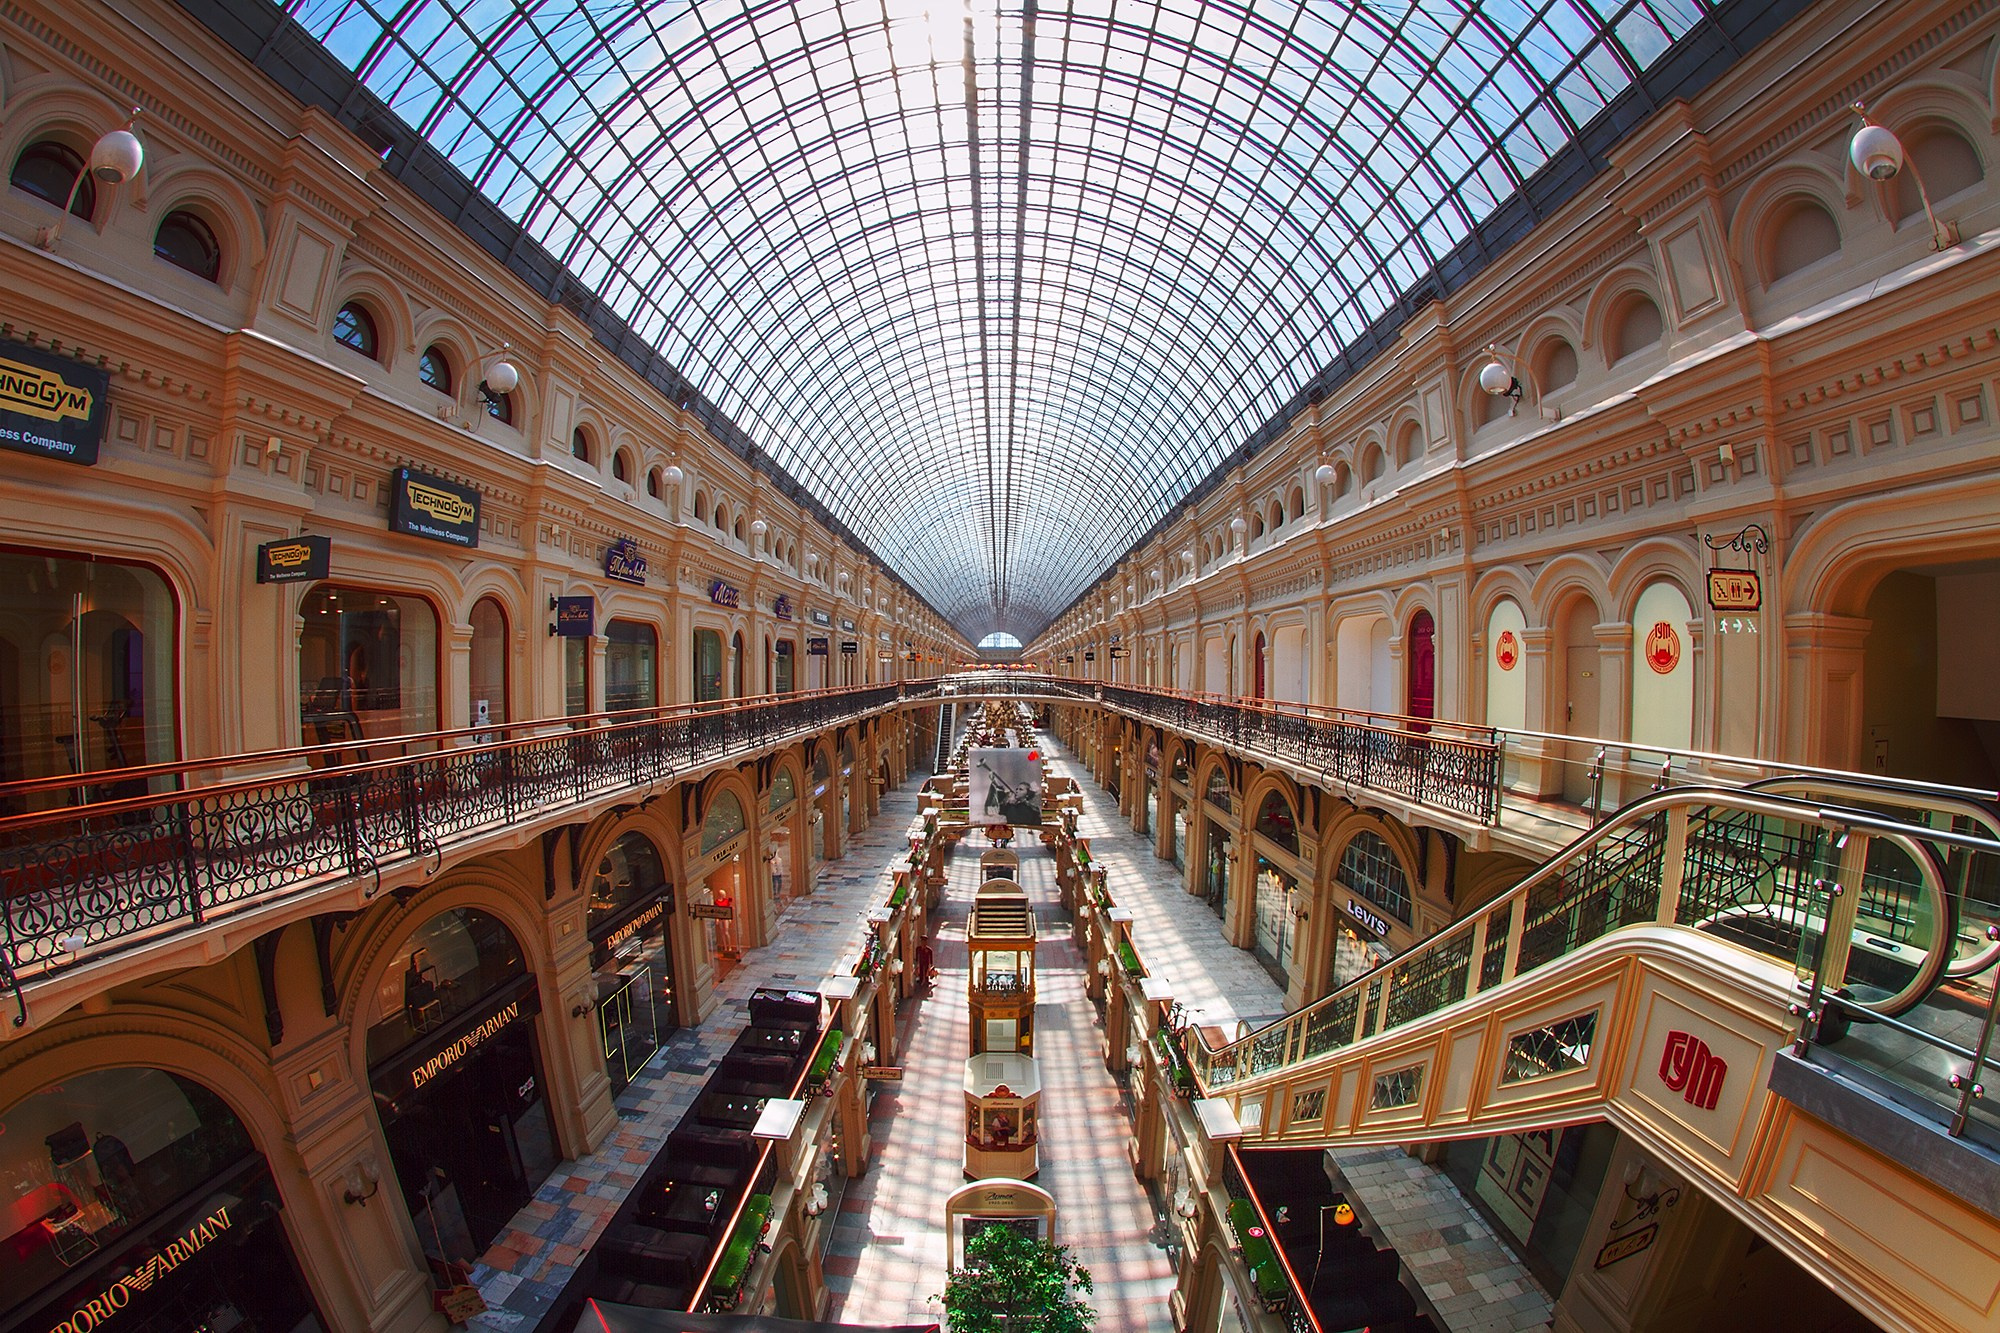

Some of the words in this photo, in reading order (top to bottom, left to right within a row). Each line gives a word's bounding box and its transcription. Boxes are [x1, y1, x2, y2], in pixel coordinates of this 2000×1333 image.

[23, 431, 76, 455] Company
[408, 521, 419, 531] The
[420, 524, 445, 537] Wellness
[445, 530, 469, 543] Company
[411, 1038, 468, 1089] EMPORIO
[480, 1001, 519, 1042] ARMANI
[1658, 1030, 1729, 1111] ГУМ
[157, 1206, 233, 1279] ARMANI
